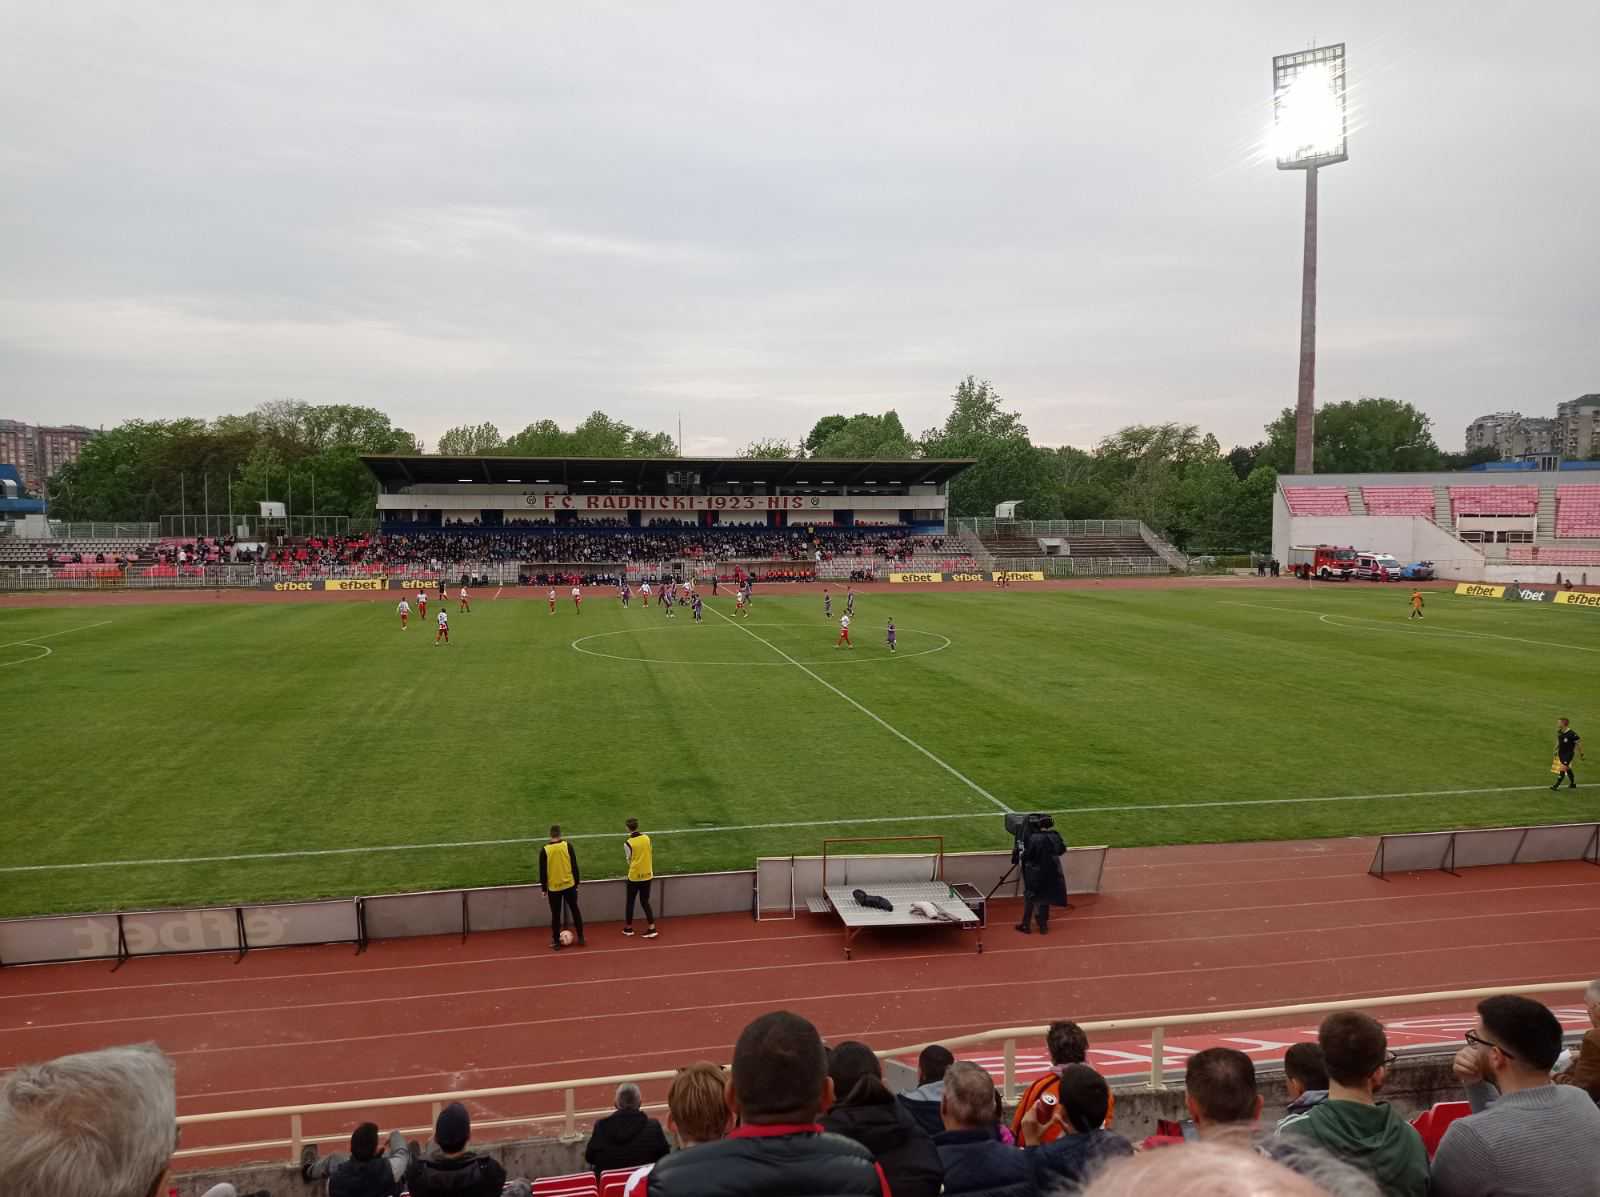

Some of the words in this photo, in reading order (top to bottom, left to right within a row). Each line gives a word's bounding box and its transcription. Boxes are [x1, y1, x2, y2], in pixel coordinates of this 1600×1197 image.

[902, 573, 932, 582] efbet
[952, 573, 983, 582] efbet
[274, 581, 312, 591] efbet
[339, 580, 377, 590] efbet
[401, 579, 438, 589] efbet
[1466, 585, 1495, 596] efbet
[1518, 590, 1545, 601] fbet
[1567, 593, 1600, 606] efbet
